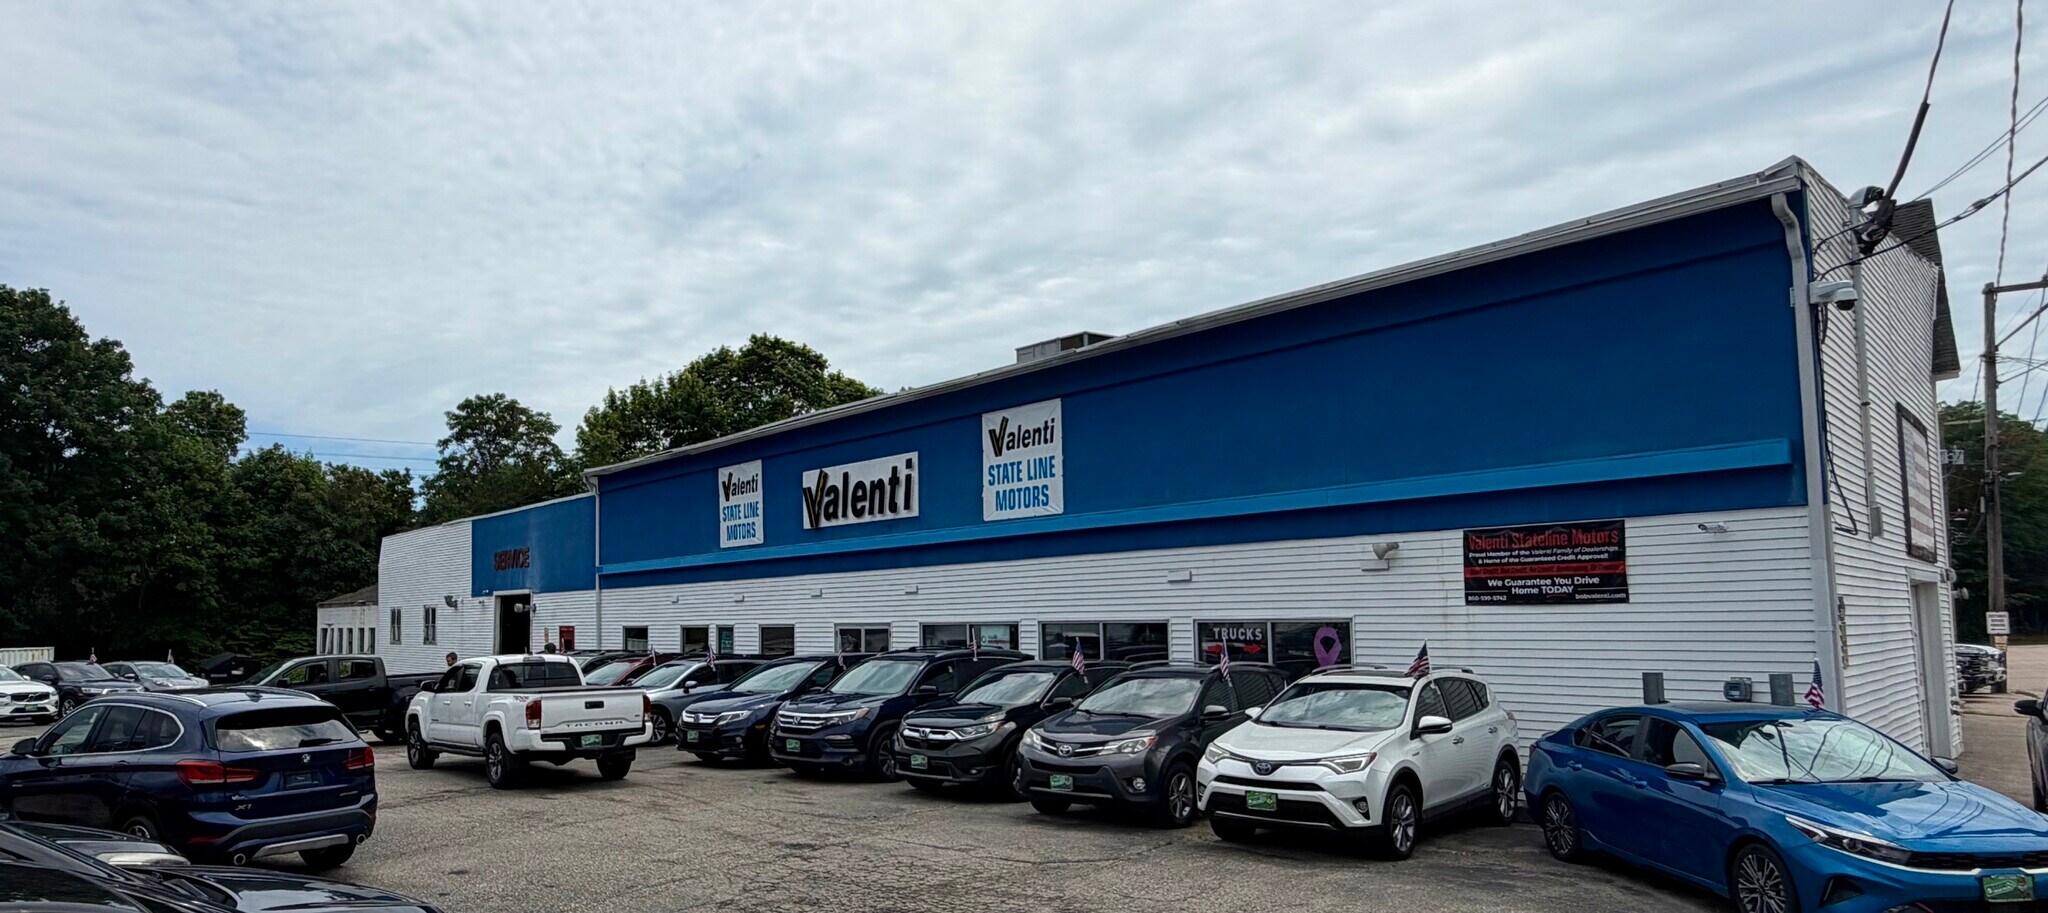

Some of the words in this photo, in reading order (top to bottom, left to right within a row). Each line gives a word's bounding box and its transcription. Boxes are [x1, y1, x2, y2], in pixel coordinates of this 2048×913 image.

[989, 416, 1055, 457] Valenti
[988, 461, 1023, 486] STATE
[1027, 455, 1056, 481] LINE
[721, 472, 758, 502] Valenti
[803, 458, 913, 529] Valenti
[995, 485, 1049, 512] MOTORS
[722, 505, 742, 522] STATE
[743, 501, 760, 518] LINE
[726, 522, 757, 541] MOTORS
[1469, 534, 1508, 550] Valenti
[1512, 531, 1567, 548] Stateline
[1571, 528, 1619, 545] Motors
[494, 548, 530, 571] SERVICE
[1487, 578, 1503, 587] We
[1505, 577, 1552, 586] Guarantee
[1554, 577, 1573, 585] You
[1574, 575, 1600, 584] Drive
[1512, 586, 1540, 595] Home
[1541, 585, 1574, 594] TODAY
[1213, 626, 1263, 641] TRUCKS
[565, 720, 623, 728] TACOMA
[235, 803, 252, 811] X1
